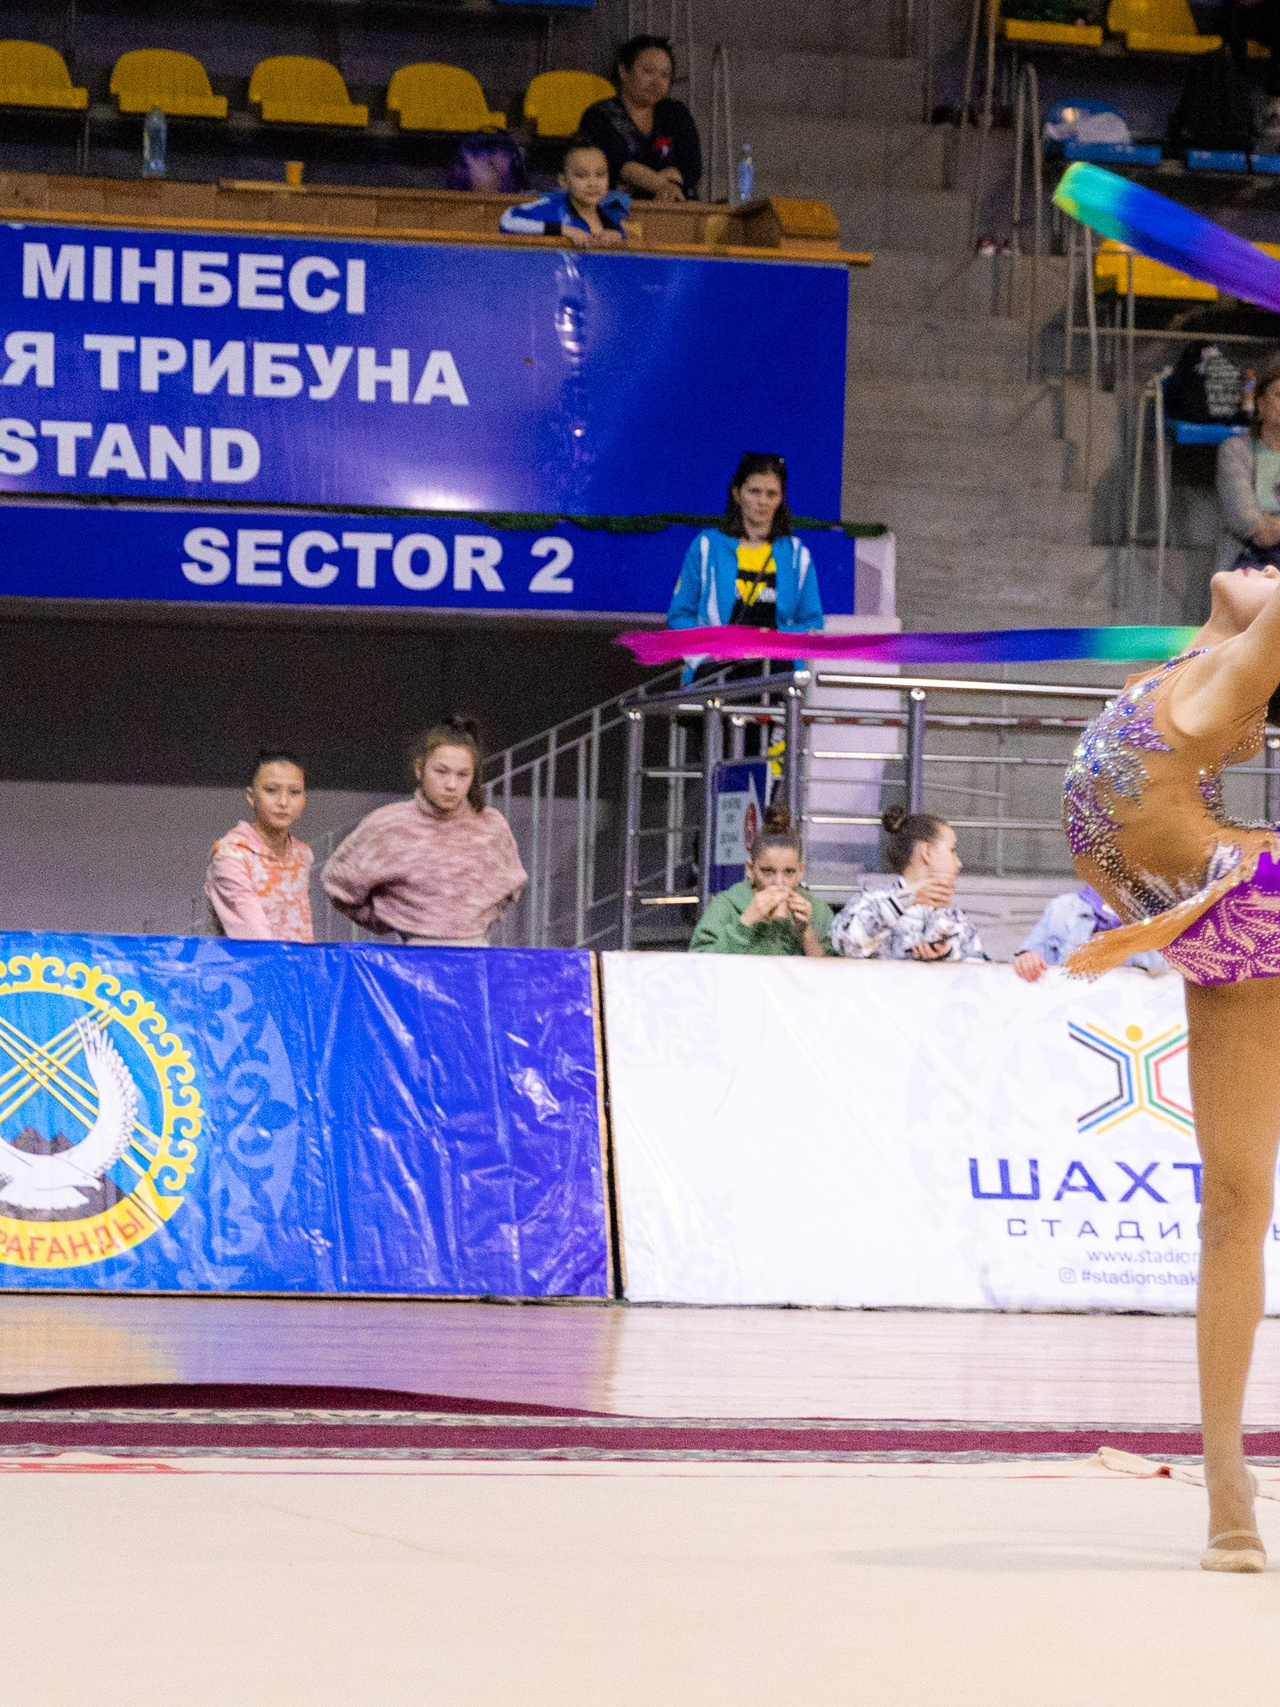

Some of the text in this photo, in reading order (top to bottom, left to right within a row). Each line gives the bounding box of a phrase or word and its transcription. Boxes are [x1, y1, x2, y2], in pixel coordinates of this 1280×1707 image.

[22, 242, 367, 315] МІНБЕСІ
[0, 330, 471, 408] Я ТРИБУНА
[0, 416, 262, 485] STAND
[180, 526, 575, 594] SECTOR 2
[1081, 1269, 1199, 1286] #stadionshak
